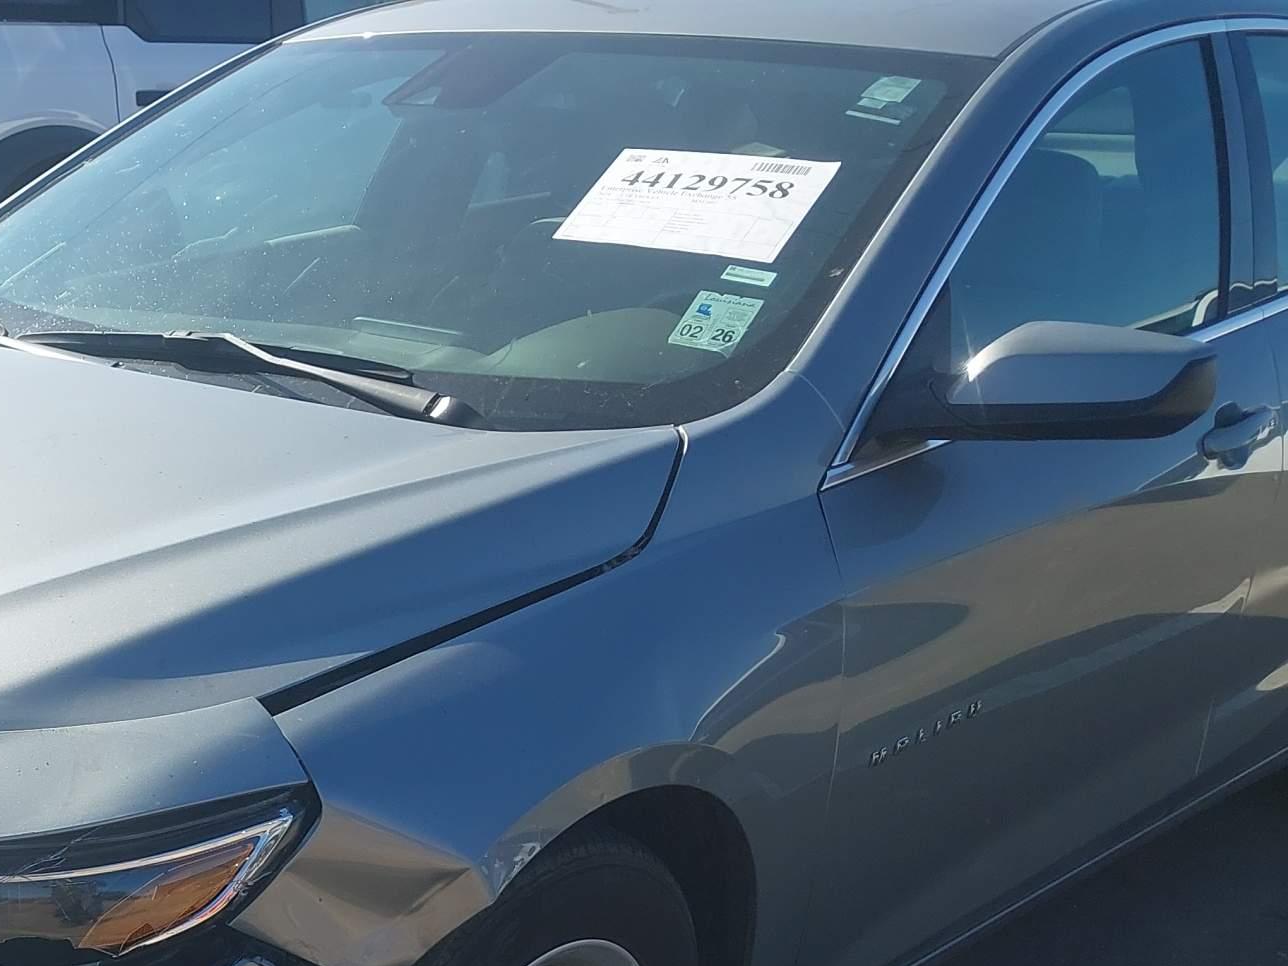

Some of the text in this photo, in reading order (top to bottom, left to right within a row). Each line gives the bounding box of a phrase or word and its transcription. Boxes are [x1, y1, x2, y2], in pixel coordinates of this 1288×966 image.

[621, 170, 795, 199] 44129758
[679, 323, 736, 343] 02 26
